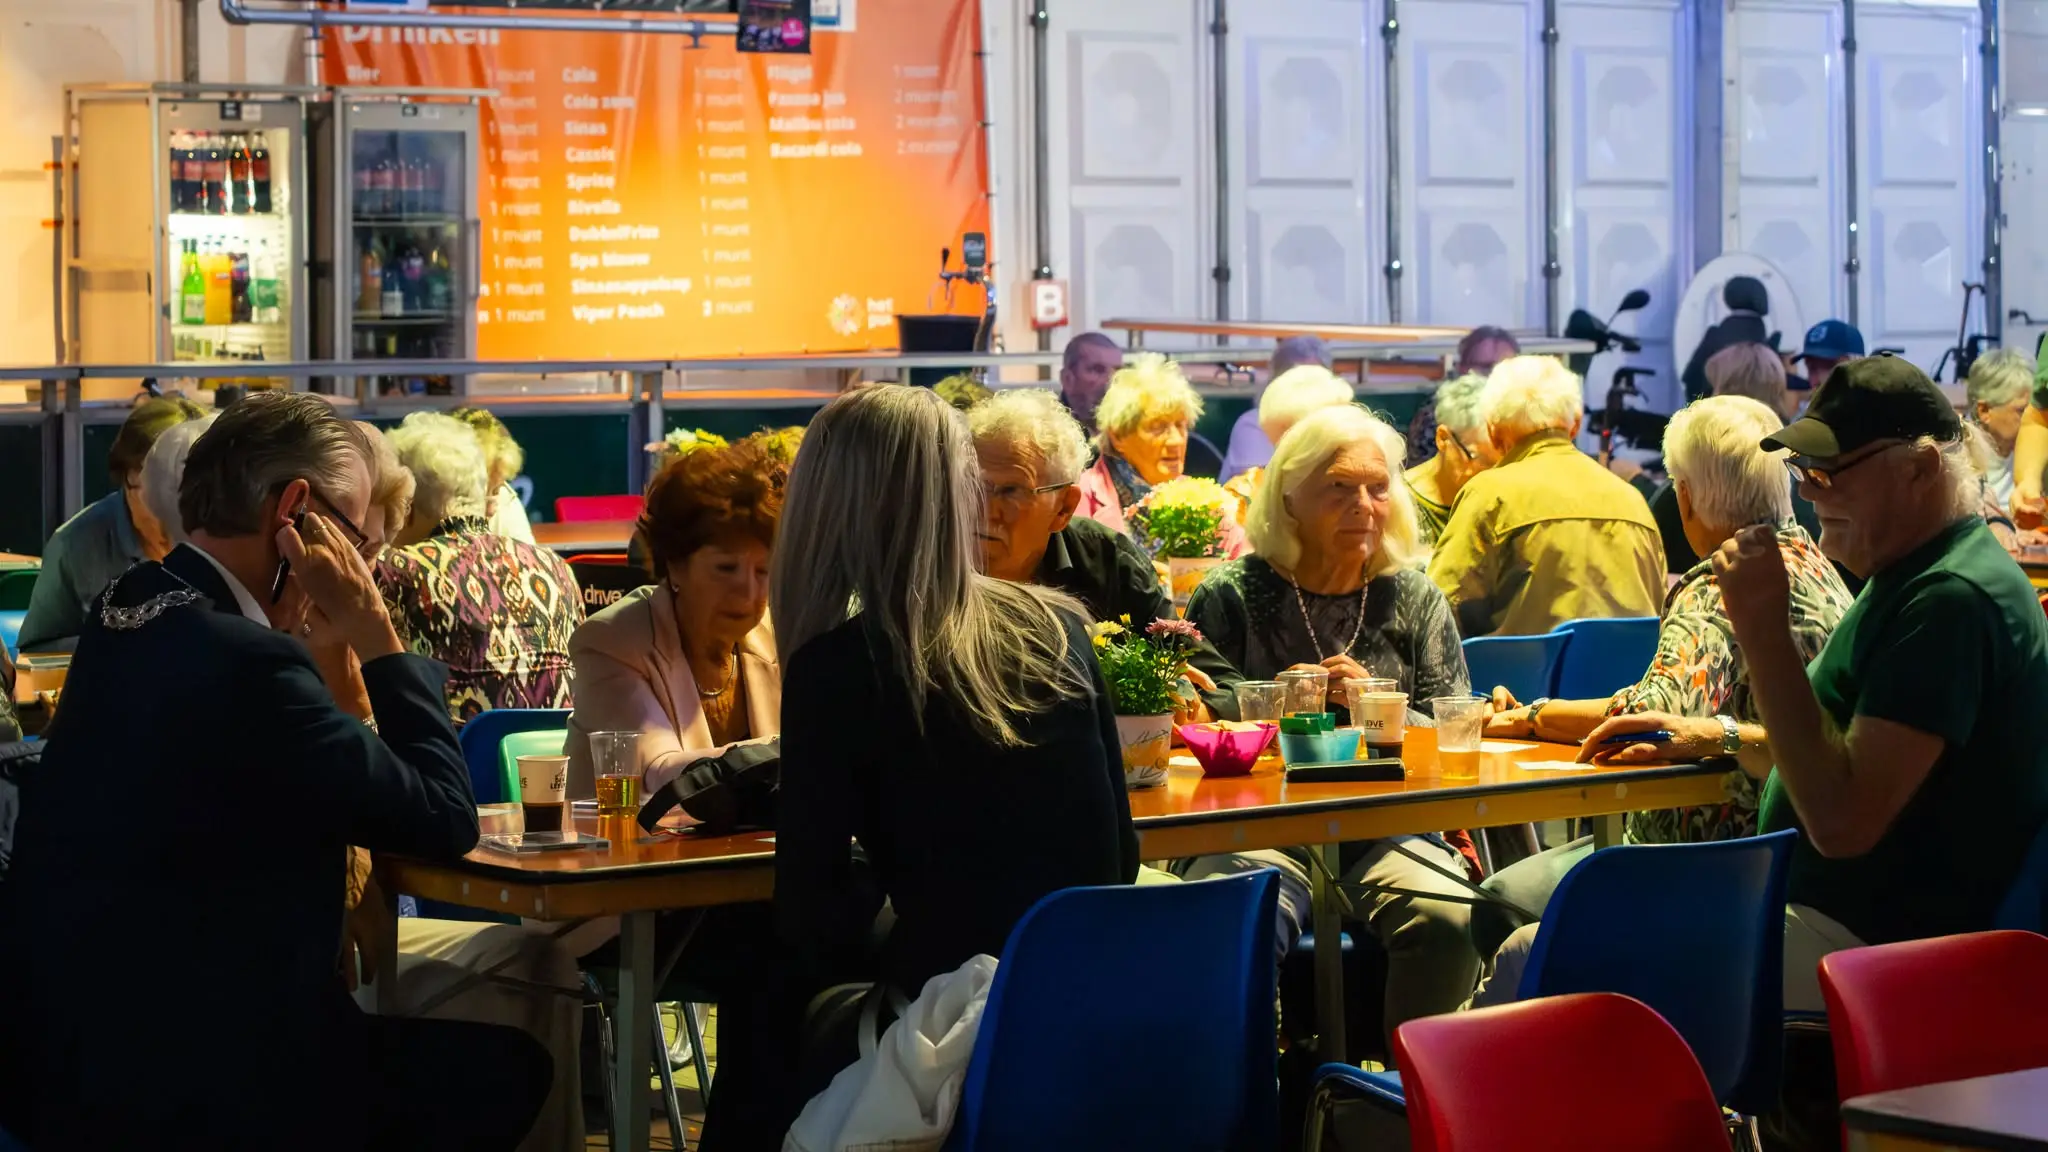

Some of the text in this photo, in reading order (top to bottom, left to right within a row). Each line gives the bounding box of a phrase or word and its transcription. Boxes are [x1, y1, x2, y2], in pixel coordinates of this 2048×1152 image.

[562, 66, 597, 83] Cola
[564, 94, 599, 109] Cola
[564, 121, 608, 136] Sinas
[565, 147, 615, 163] Cassis
[770, 141, 829, 158] Bacardi
[831, 142, 863, 157] cola
[567, 173, 615, 191] Sprite
[710, 171, 748, 185] munt
[503, 202, 541, 216] munt
[567, 198, 622, 215] Rivella
[711, 197, 748, 211] munt
[504, 229, 542, 243] munt
[712, 223, 750, 236] munt
[504, 255, 543, 269] munt
[570, 252, 599, 271] Spa
[714, 249, 751, 263] munt
[506, 282, 544, 296] munt
[715, 275, 752, 288] munt
[1037, 284, 1063, 321] B
[507, 308, 545, 322] munt
[571, 303, 614, 324] Viper
[617, 301, 665, 319] Peach
[716, 302, 755, 315] munt
[585, 584, 622, 605] drive
